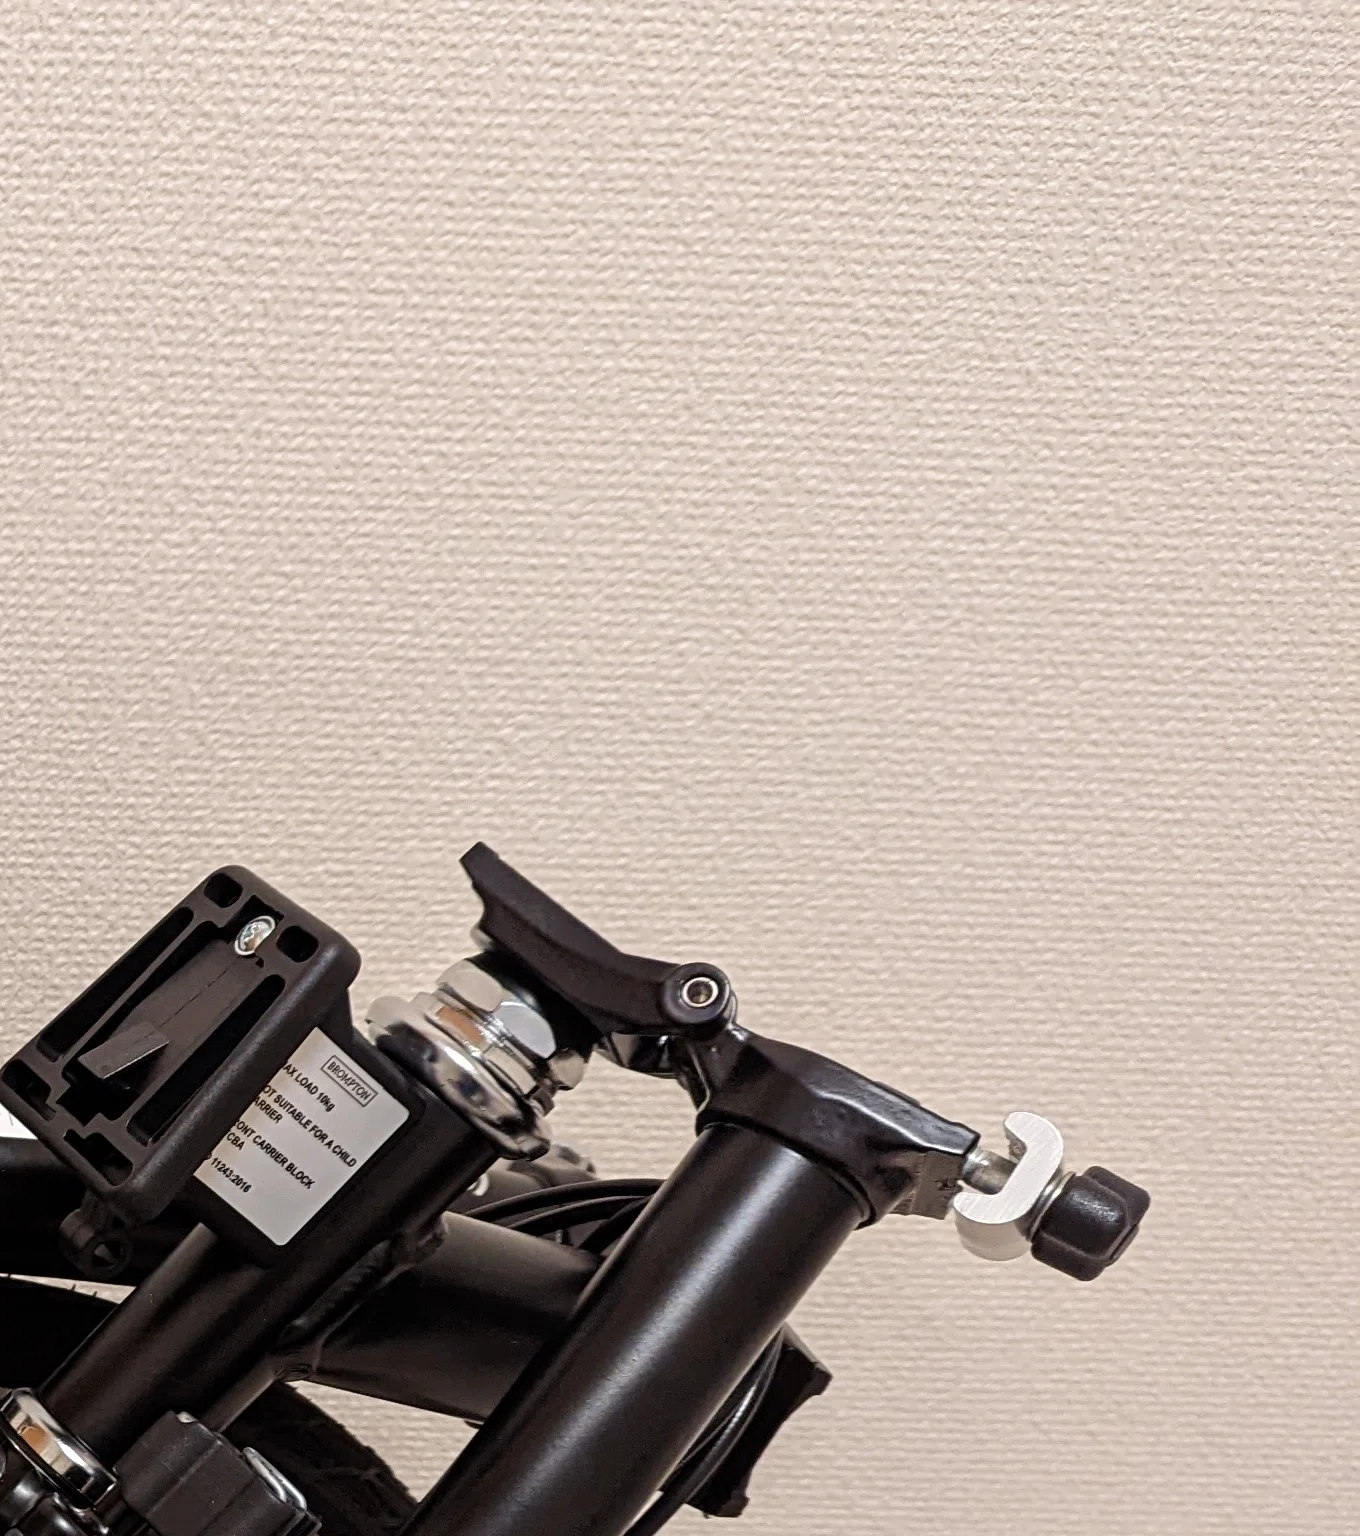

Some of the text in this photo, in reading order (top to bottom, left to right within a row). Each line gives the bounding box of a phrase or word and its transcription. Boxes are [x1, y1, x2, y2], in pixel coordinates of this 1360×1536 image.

[281, 1063, 336, 1113] AX LOAD 10kg
[327, 1061, 372, 1101] BROMPTON
[253, 1095, 284, 1124] ARRIER
[263, 1084, 357, 1168] OT SUITABLE FOR A CHILD
[226, 1131, 246, 1151] CBA
[234, 1120, 316, 1190] ONT CARRIER BLOCK
[210, 1157, 253, 1193] 11243:2016
